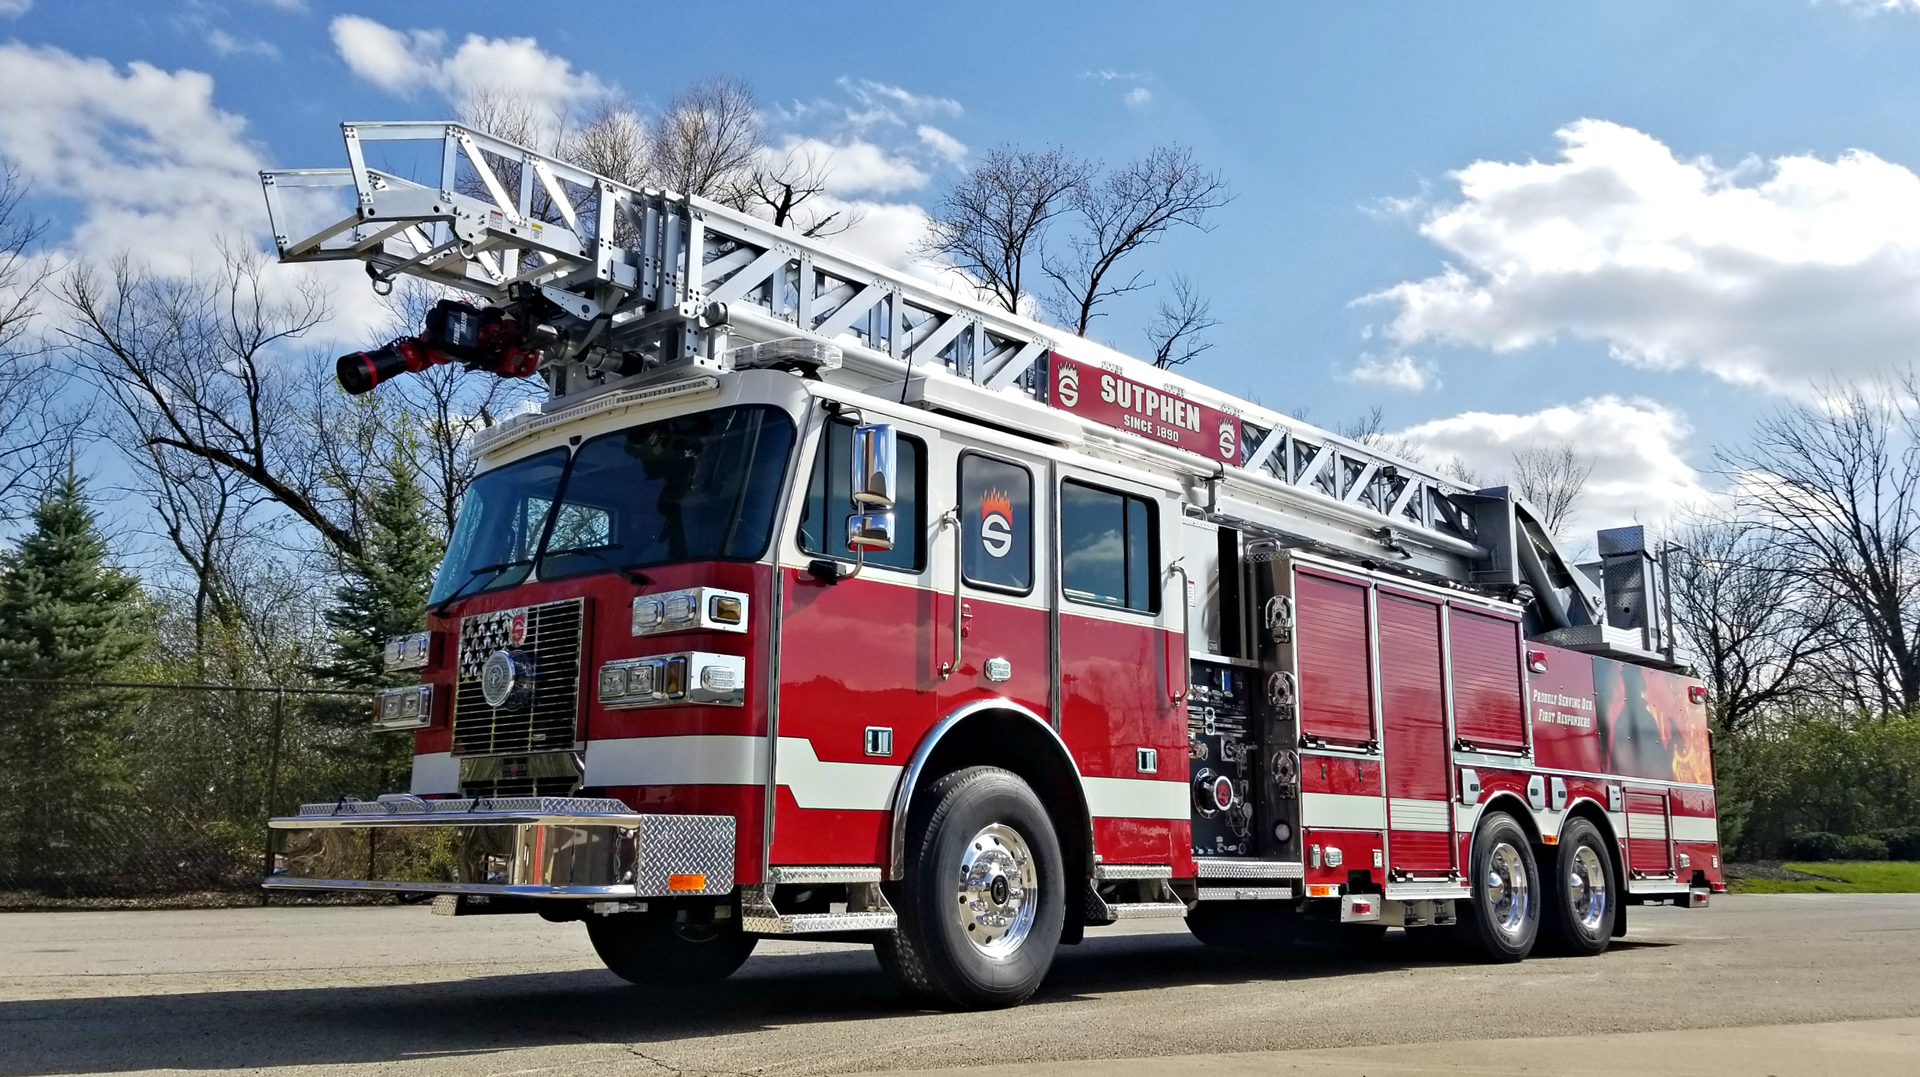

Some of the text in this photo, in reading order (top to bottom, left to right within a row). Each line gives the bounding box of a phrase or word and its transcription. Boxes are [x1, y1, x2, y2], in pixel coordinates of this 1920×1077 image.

[1101, 374, 1200, 433] SUTPHEN
[1123, 414, 1179, 442] SINCE 1890
